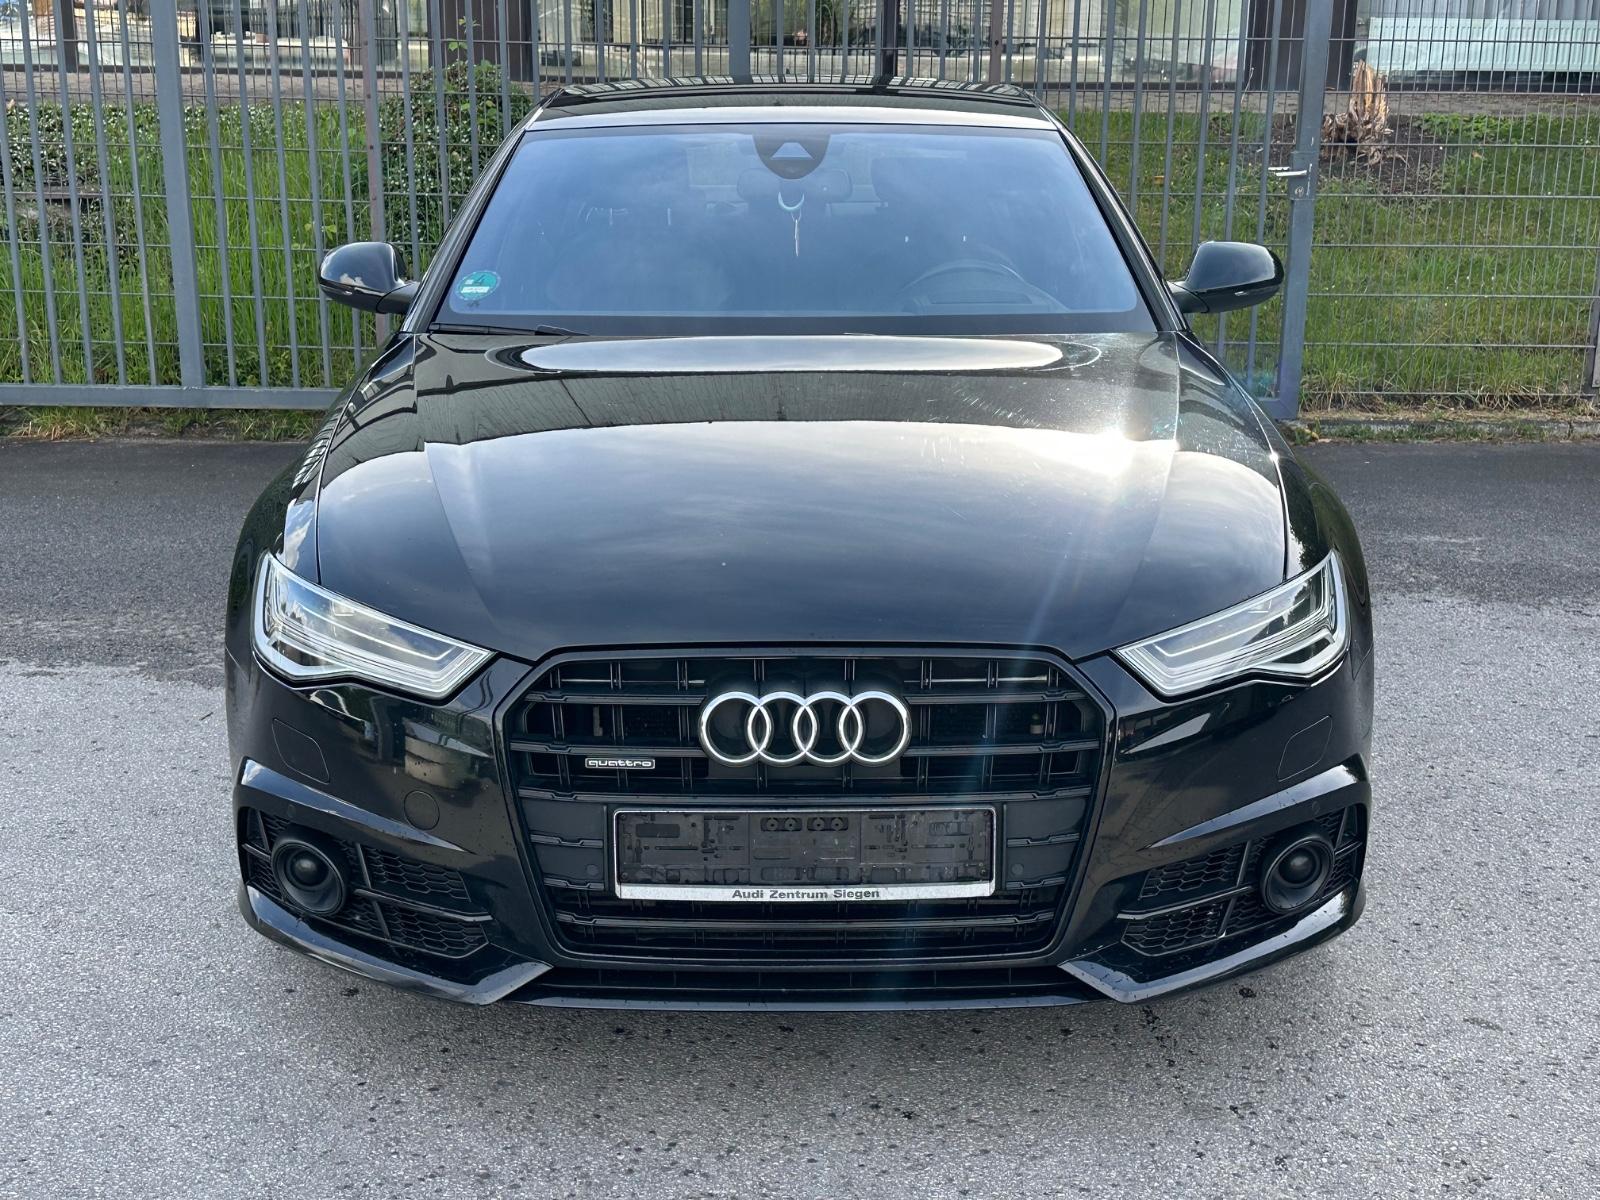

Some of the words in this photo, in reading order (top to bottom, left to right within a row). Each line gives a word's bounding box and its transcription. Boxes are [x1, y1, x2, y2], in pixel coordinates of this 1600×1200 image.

[588, 759, 652, 768] quattro
[731, 889, 764, 899] Audi
[769, 889, 828, 899] Zentrum
[833, 889, 880, 899] Siegen
